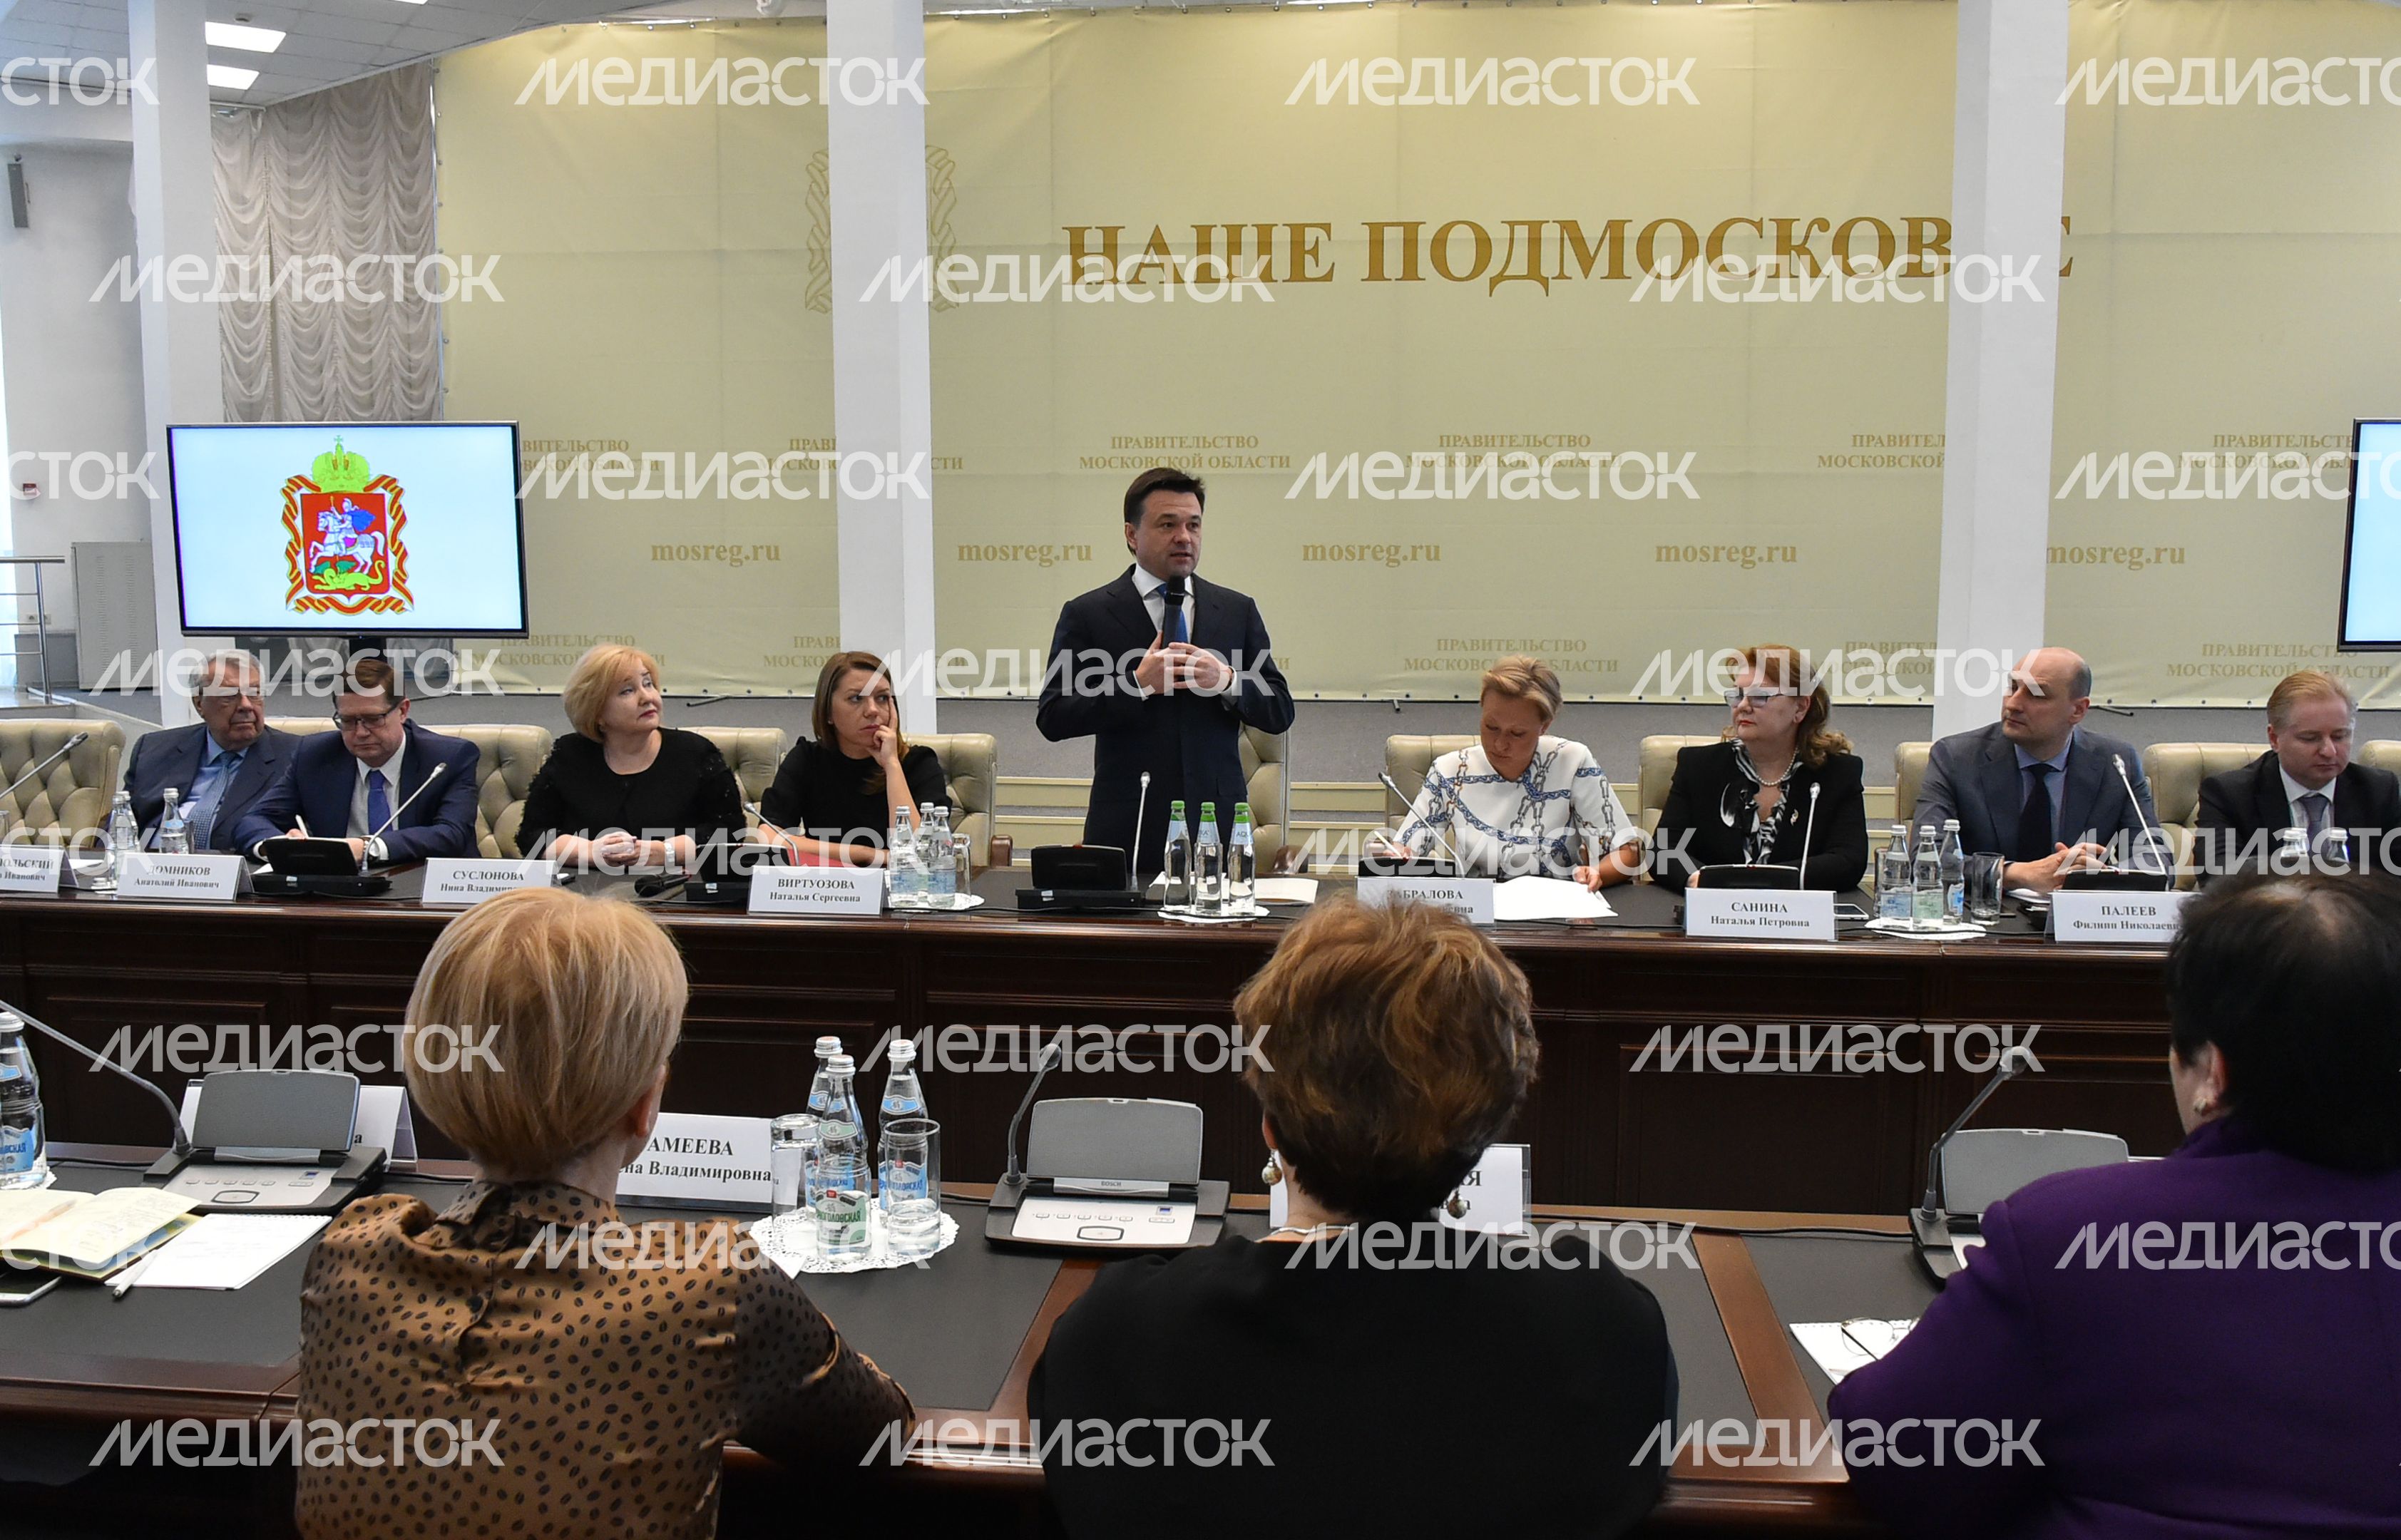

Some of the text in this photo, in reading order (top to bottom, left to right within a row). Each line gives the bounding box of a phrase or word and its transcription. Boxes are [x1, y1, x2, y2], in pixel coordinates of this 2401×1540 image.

[1062, 223, 1335, 285] НАШЕ
[1111, 435, 1259, 449] ПРАВИТЕЛЬСТВО
[1438, 434, 1591, 448] ПРАВИТЕЛЬСТВО
[1080, 453, 1291, 469] МОСКОВСКОЙ ОБЛАСТИ
[651, 540, 781, 568] mosreg.ru
[958, 542, 1092, 568] mosreg.ru
[1302, 542, 1441, 568] mosreg.ru
[1655, 542, 1797, 569] mosreg.ru
[1437, 639, 1587, 652] ПРАВИТЕЛЬСТВО
[453, 870, 525, 881] СУСЛОНОВА
[440, 883, 464, 892] Нина
[777, 878, 855, 889] ВИРТУОЗОВА
[769, 891, 861, 903] Наталья Сергеевна
[1731, 901, 1788, 913] САНИНА
[2101, 905, 2157, 916] ПАЛЕЕВ
[1711, 915, 1810, 928] Наталья Петровна
[2073, 920, 2118, 930] Филипп
[648, 1160, 772, 1183] Владимировна
